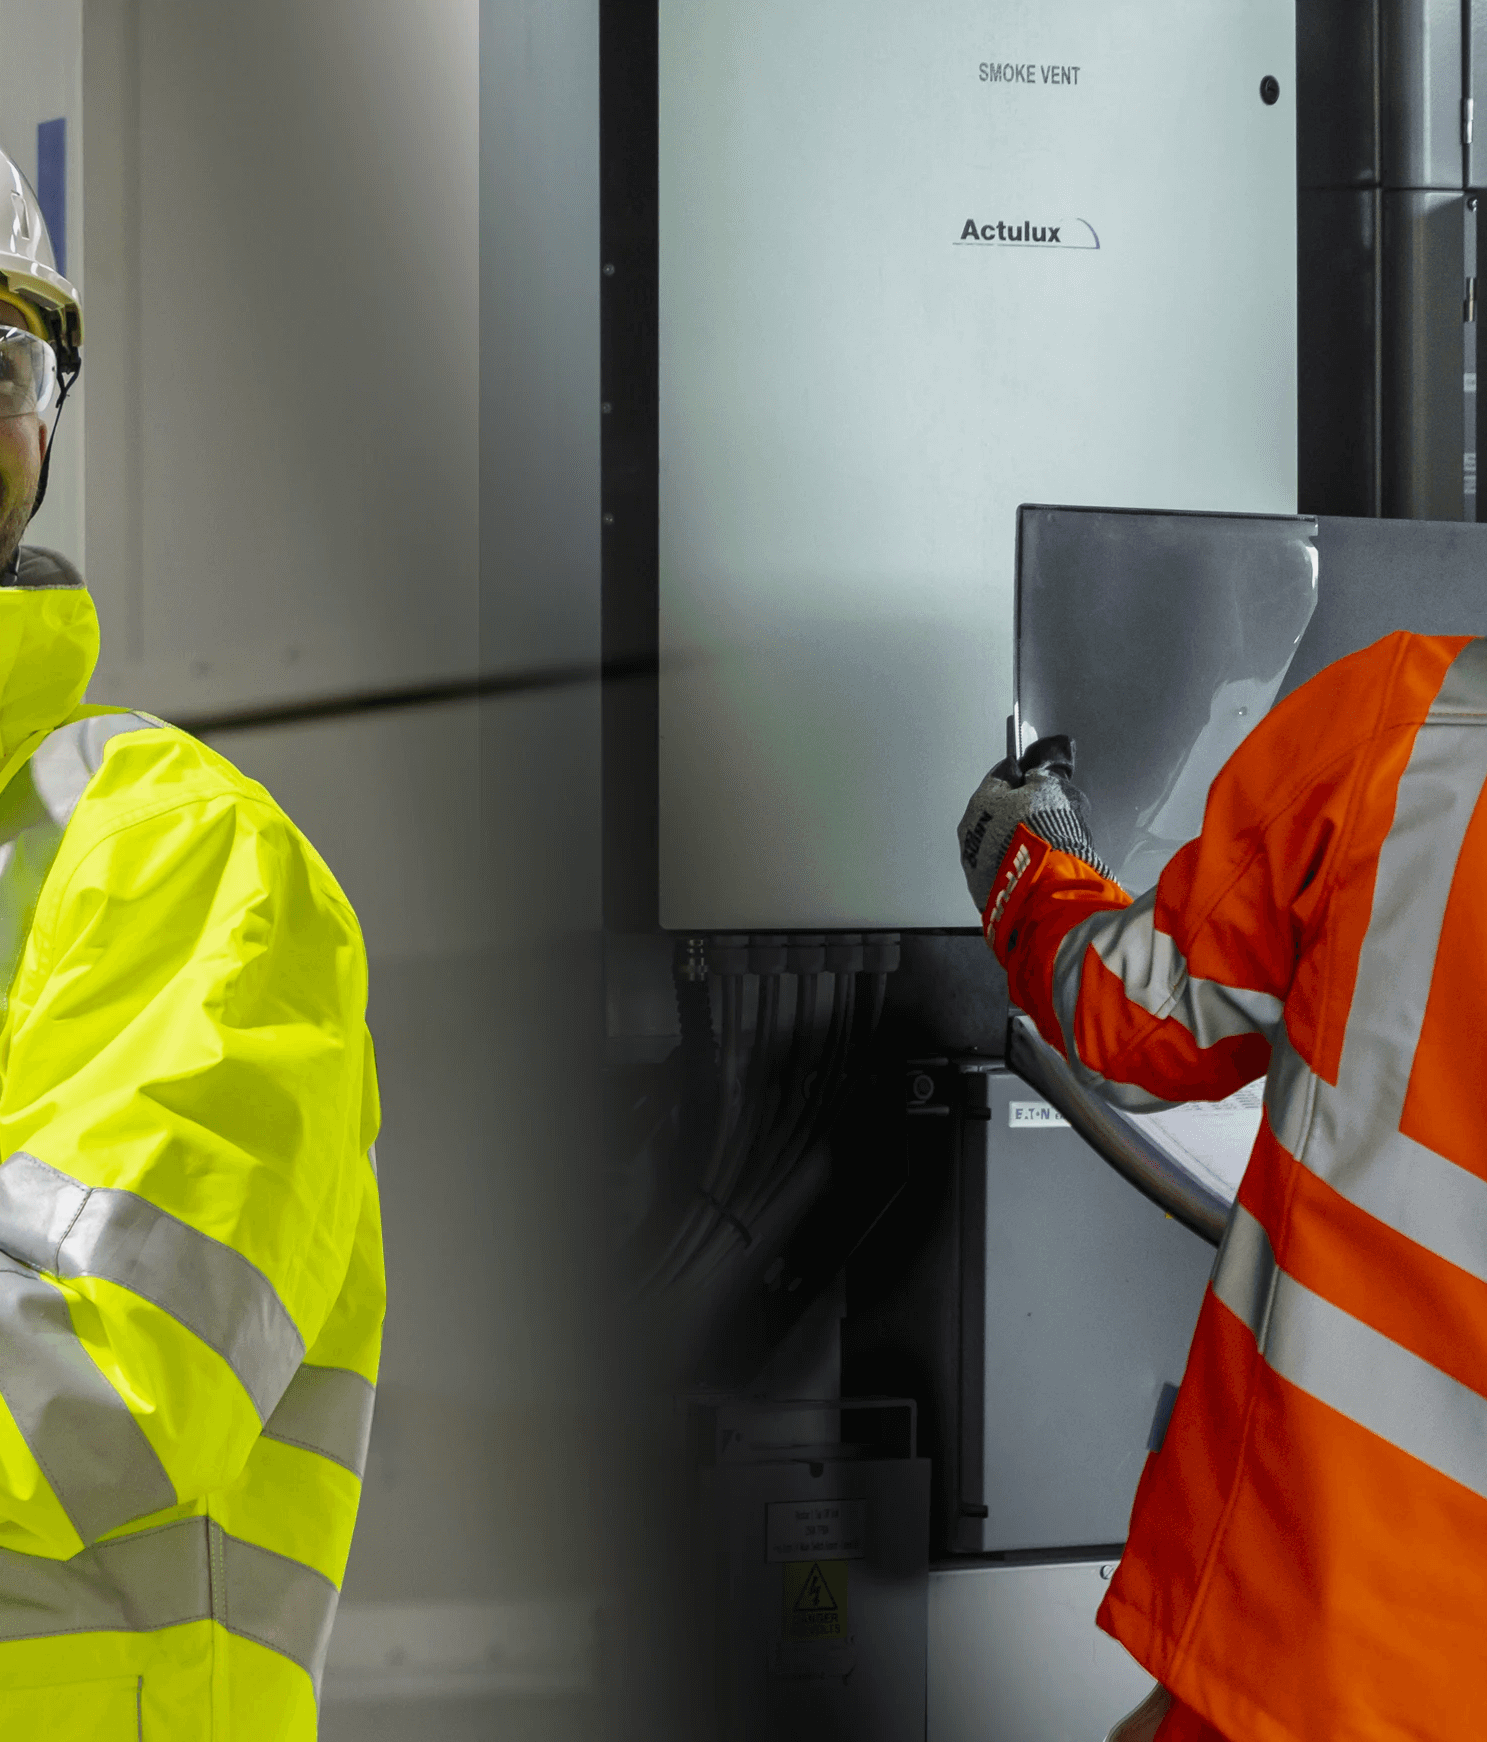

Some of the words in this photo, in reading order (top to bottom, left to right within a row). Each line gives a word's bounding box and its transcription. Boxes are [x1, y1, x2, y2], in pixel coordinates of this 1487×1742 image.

[978, 62, 1036, 84] SMOKE
[1041, 65, 1081, 85] VENT
[960, 218, 1061, 243] Actulux
